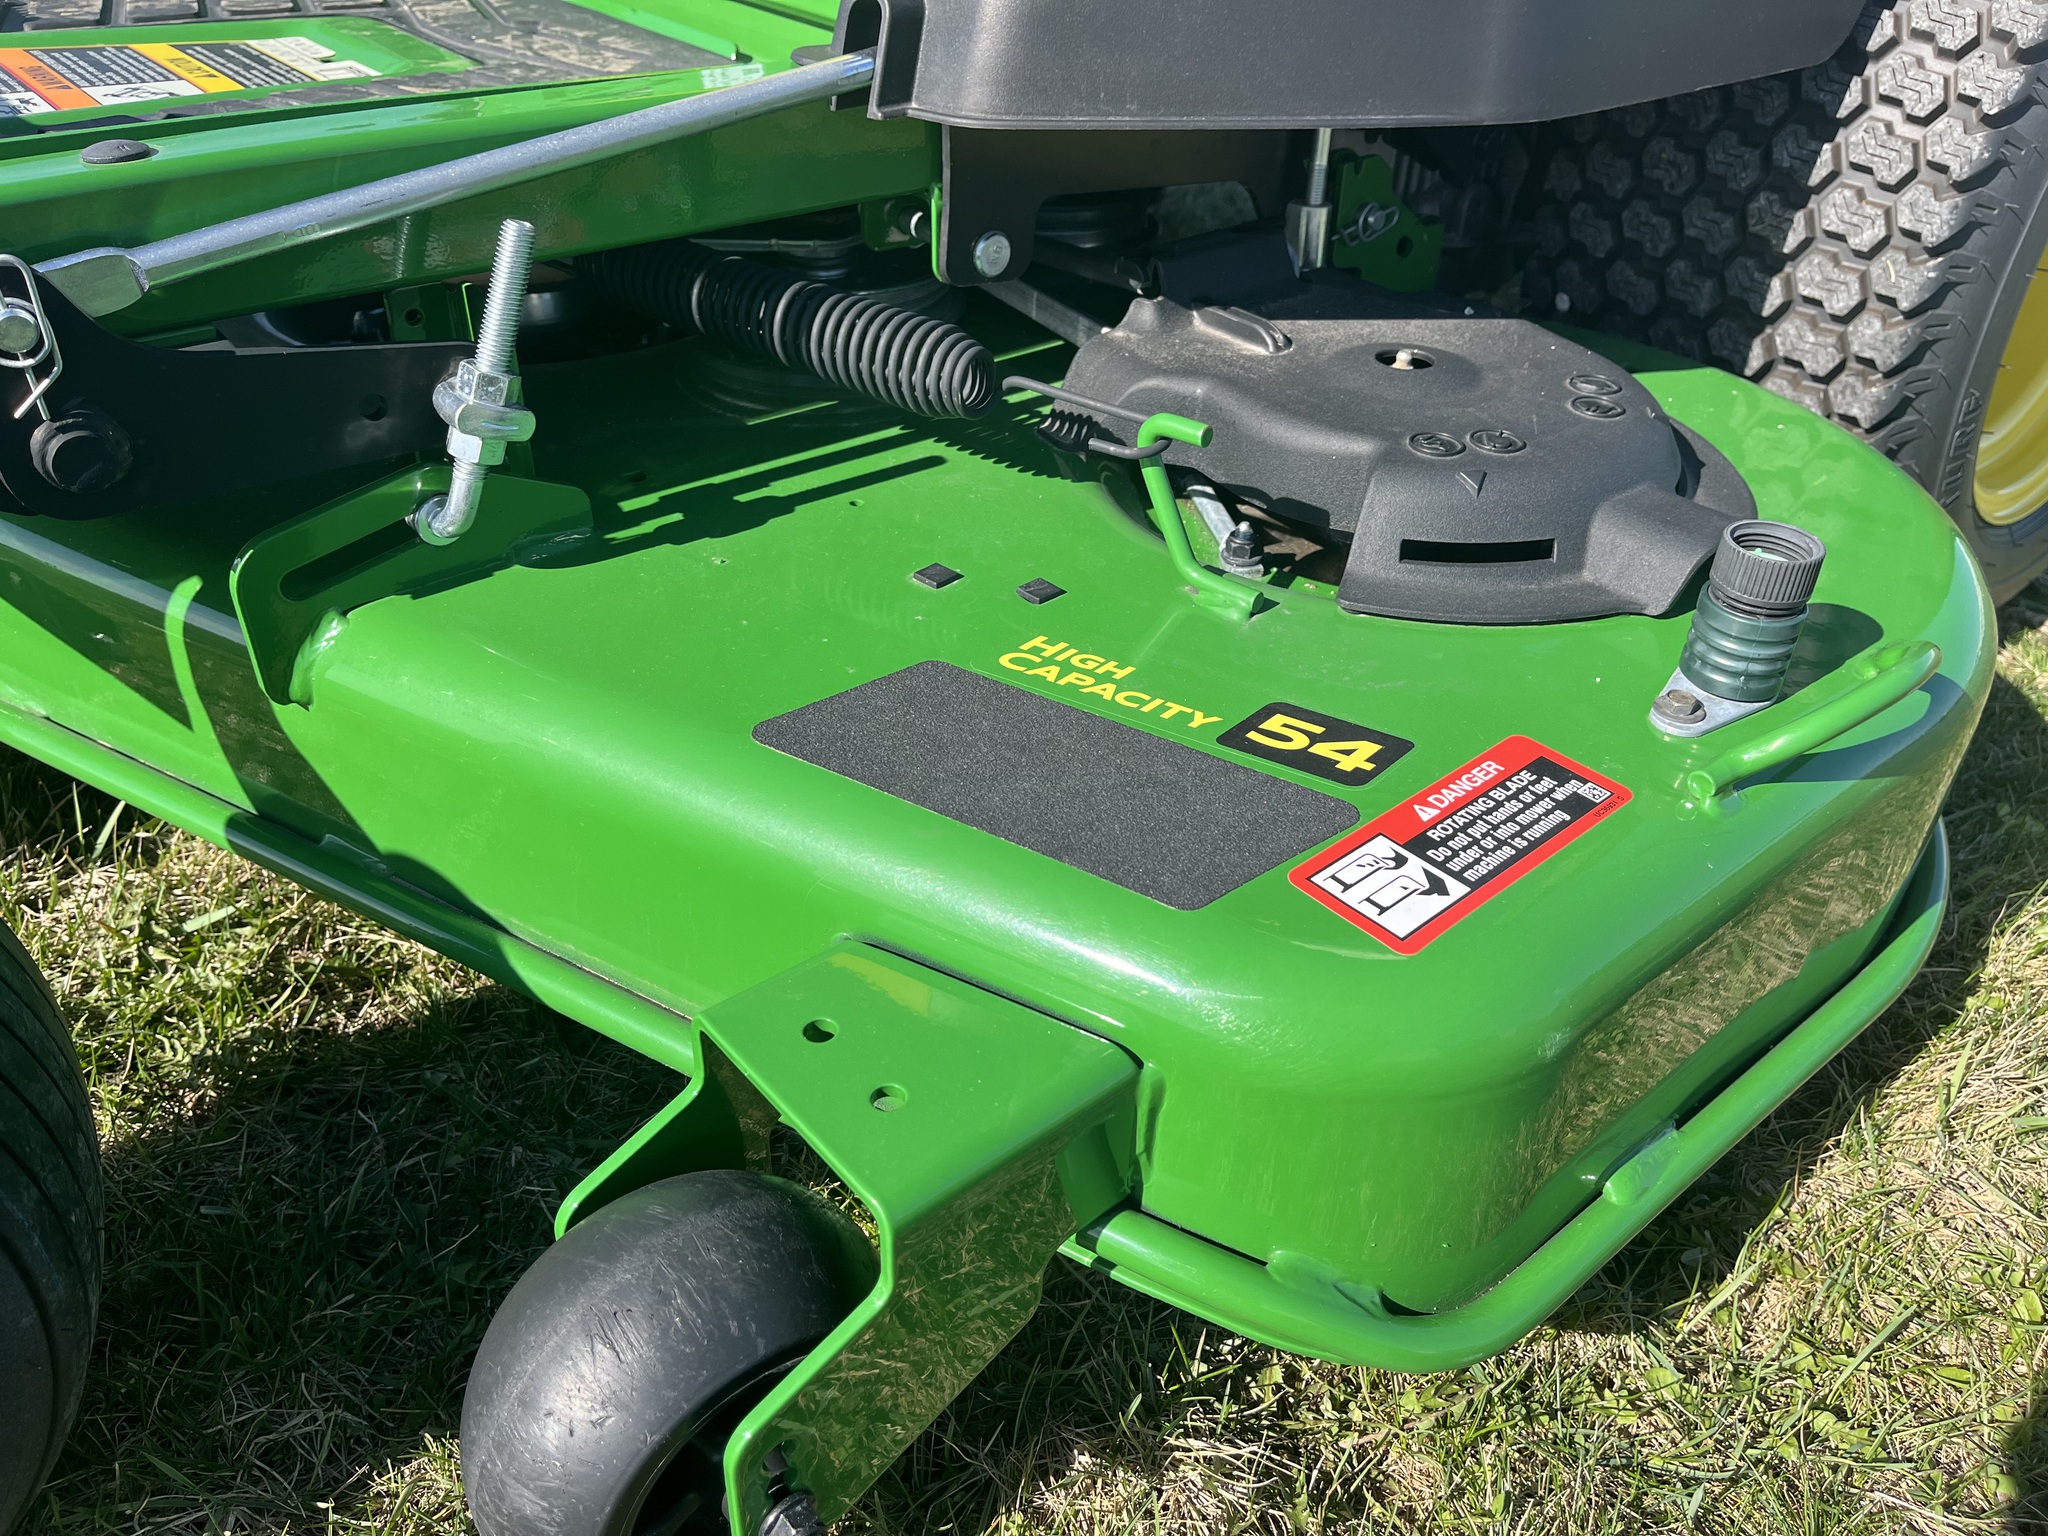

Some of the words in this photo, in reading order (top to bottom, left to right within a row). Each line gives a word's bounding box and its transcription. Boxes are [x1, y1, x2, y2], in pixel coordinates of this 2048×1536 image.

[998, 652, 1223, 729] CAPACITY
[1018, 635, 1136, 679] HIGH
[1245, 713, 1383, 772] 54
[1426, 797, 1496, 841] ROTATING
[1488, 770, 1538, 801] BLADE
[1426, 846, 1452, 862] Do
[1446, 832, 1473, 850] not
[1466, 819, 1492, 840] put
[1482, 799, 1524, 825] hands
[1519, 790, 1536, 803] or
[1528, 776, 1558, 795] feet
[1427, 760, 1505, 809] DANGER
[1445, 845, 1484, 871] under
[1480, 836, 1498, 849] or
[1489, 821, 1520, 840] into
[1515, 797, 1556, 825] mower
[1550, 779, 1584, 801] when
[1462, 845, 1516, 882] machine
[1507, 837, 1528, 849] is
[1522, 809, 1571, 841] running
